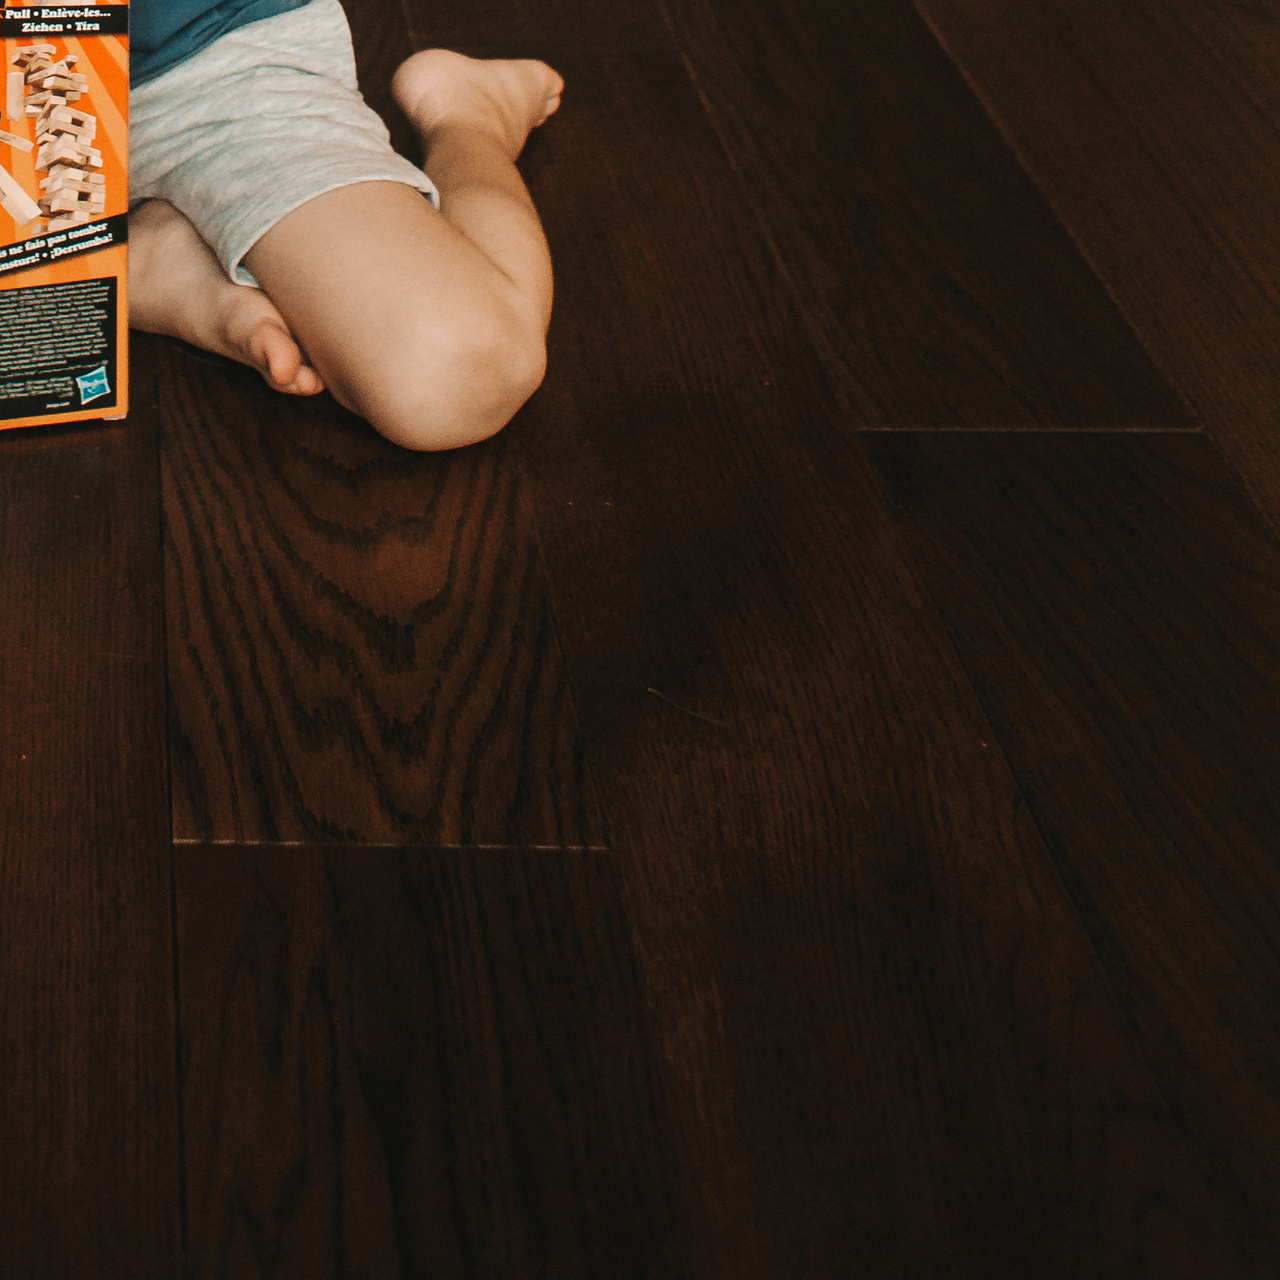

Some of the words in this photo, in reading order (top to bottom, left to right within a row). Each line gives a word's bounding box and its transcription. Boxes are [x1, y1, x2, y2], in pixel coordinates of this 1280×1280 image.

[5, 9, 31, 19] Pull
[21, 22, 63, 32] Ziehen
[75, 21, 100, 31] Tira
[9, 244, 24, 255] ne
[25, 239, 46, 251] fais
[46, 234, 67, 248] pas
[68, 223, 108, 239] tomber
